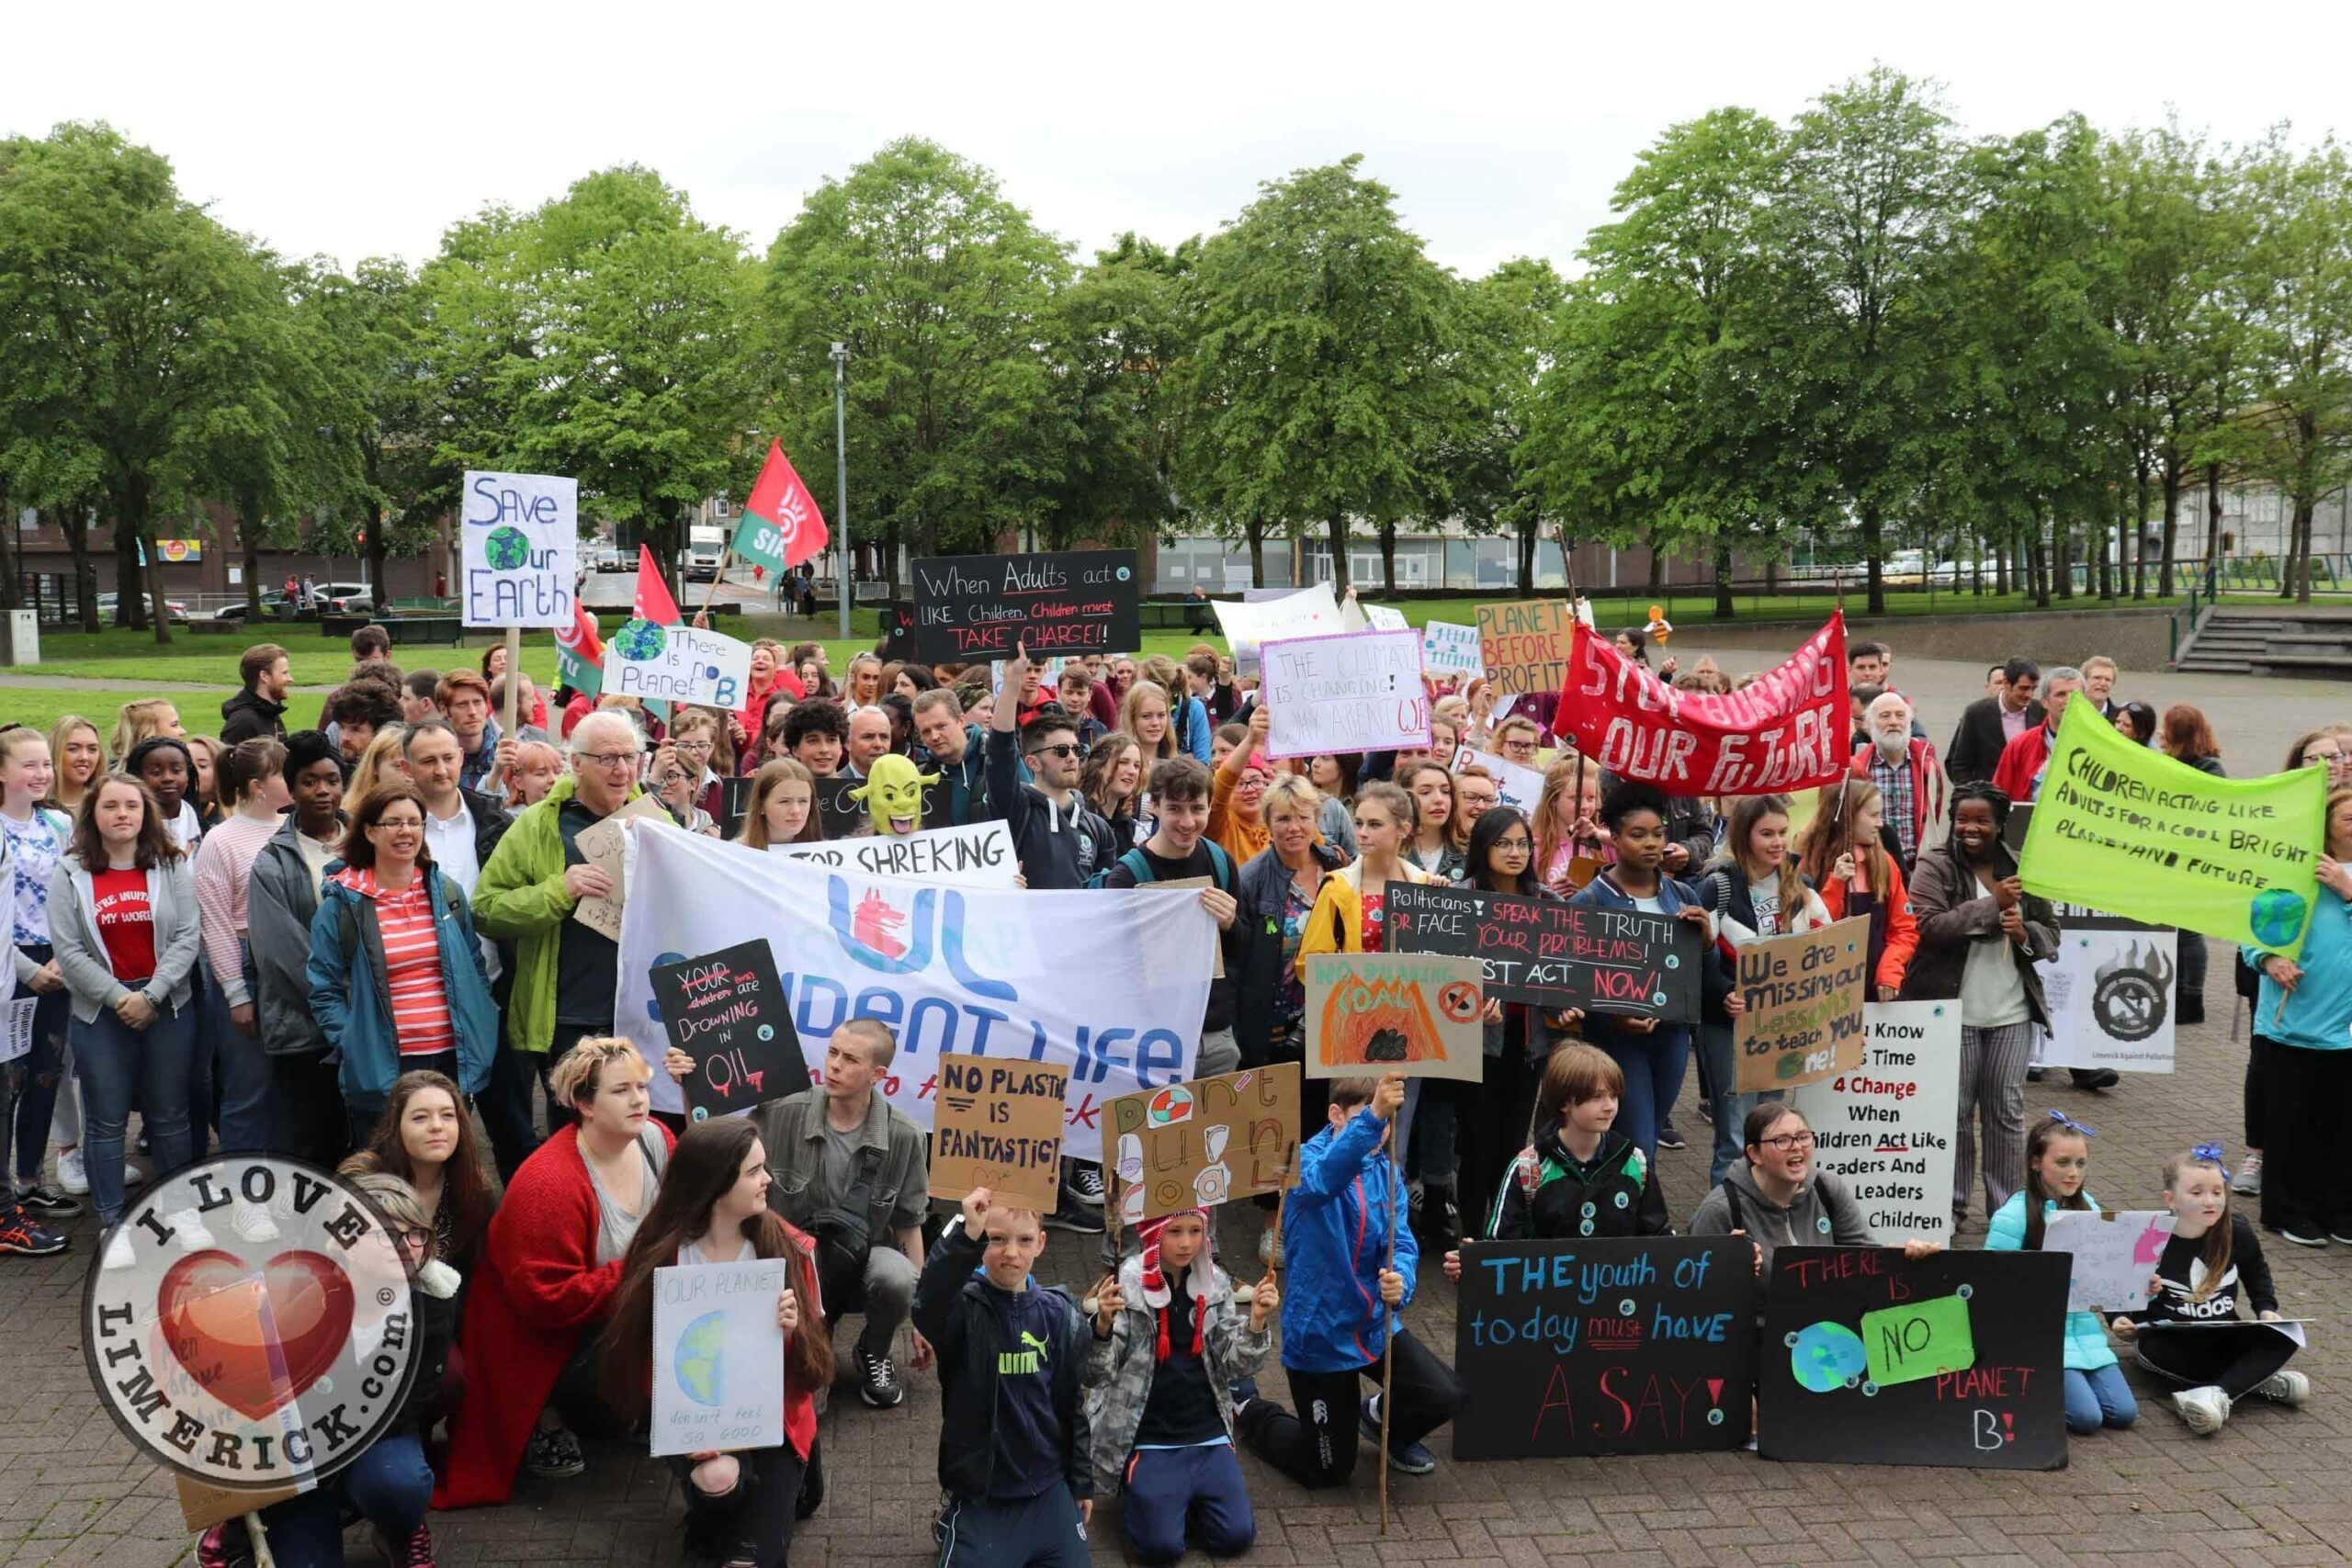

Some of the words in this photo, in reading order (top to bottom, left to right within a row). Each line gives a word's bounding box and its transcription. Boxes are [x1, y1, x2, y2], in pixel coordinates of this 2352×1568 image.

[921, 565, 989, 597] When
[1003, 561, 1068, 592] Adults
[1083, 564, 1111, 584] act
[921, 605, 955, 626] LIKE
[1031, 603, 1078, 619] Children
[1477, 602, 1565, 637] PLANET
[672, 630, 728, 658] There
[947, 627, 1011, 650] TAKE
[1482, 631, 1565, 668] BEFORE
[1278, 650, 1323, 680] THE
[715, 677, 737, 708] B
[1274, 685, 1293, 704] IS
[1273, 710, 1320, 746] WHY
[1398, 696, 1427, 734] WE
[1599, 716, 1697, 781] OUR
[1705, 703, 1838, 793] FUTURE
[2068, 747, 2155, 802] CHILDREN
[2158, 791, 2221, 814] ACTING
[2228, 803, 2277, 818] LIKE
[2056, 780, 2114, 818] ADULTS
[2120, 807, 2151, 831] FOR
[2170, 823, 2221, 843] COOL
[2230, 829, 2309, 863] BRIGHT
[858, 829, 1005, 874] SHREKING
[2129, 840, 2179, 867] AND
[2187, 858, 2269, 889] FUTURE
[102, 912, 117, 925] MY
[121, 909, 153, 923] WORL
[1492, 901, 1542, 925] SPEAK
[1546, 908, 1588, 933] THE
[1597, 912, 1674, 945] TRUTH
[1390, 911, 1413, 931] OR
[1418, 914, 1467, 936] FACE
[1476, 922, 1532, 954] YOUR
[1539, 933, 1649, 964] PROBLEMS!
[1526, 964, 1574, 986] ACT
[1740, 951, 1788, 986] We
[1801, 944, 1836, 971] are
[737, 979, 759, 995] are
[1338, 983, 1412, 1016] COAL
[1744, 973, 1833, 1012] missing
[1836, 962, 1865, 987] our
[1752, 987, 1851, 1037] Lessons
[718, 1029, 731, 1044] IN
[1744, 1034, 1770, 1056] to
[1776, 1028, 1823, 1050] teach
[1875, 1021, 1925, 1039] Know
[706, 1047, 763, 1098] OIL
[1872, 1050, 1916, 1066] Time
[944, 1064, 983, 1093] NO
[1833, 1077, 1846, 1093] 4
[1850, 1077, 1917, 1100] Change
[989, 1101, 1009, 1122] IS
[1848, 1105, 1900, 1122] When
[1813, 1131, 1871, 1149] hildren
[1877, 1132, 1907, 1148] Act
[1912, 1132, 1947, 1150] Like
[1891, 1157, 1926, 1175] And
[1855, 1181, 1924, 1201] Leaders
[1869, 1210, 1942, 1230] Children
[1481, 1255, 1576, 1295] THE
[1577, 1252, 1657, 1304] youth
[1785, 1251, 1883, 1288] THERE
[664, 1273, 707, 1305] OUR
[715, 1269, 782, 1296] PLANET
[1889, 1274, 1910, 1300] IS
[2165, 1295, 2233, 1318] didas
[1471, 1305, 1579, 1354] today
[1588, 1317, 1643, 1338] must
[1883, 1318, 1930, 1372] NO
[1935, 1366, 2036, 1401] PLANET
[1531, 1363, 1575, 1442] A
[1593, 1366, 1724, 1441] SAY!
[1973, 1409, 2014, 1450] B!
